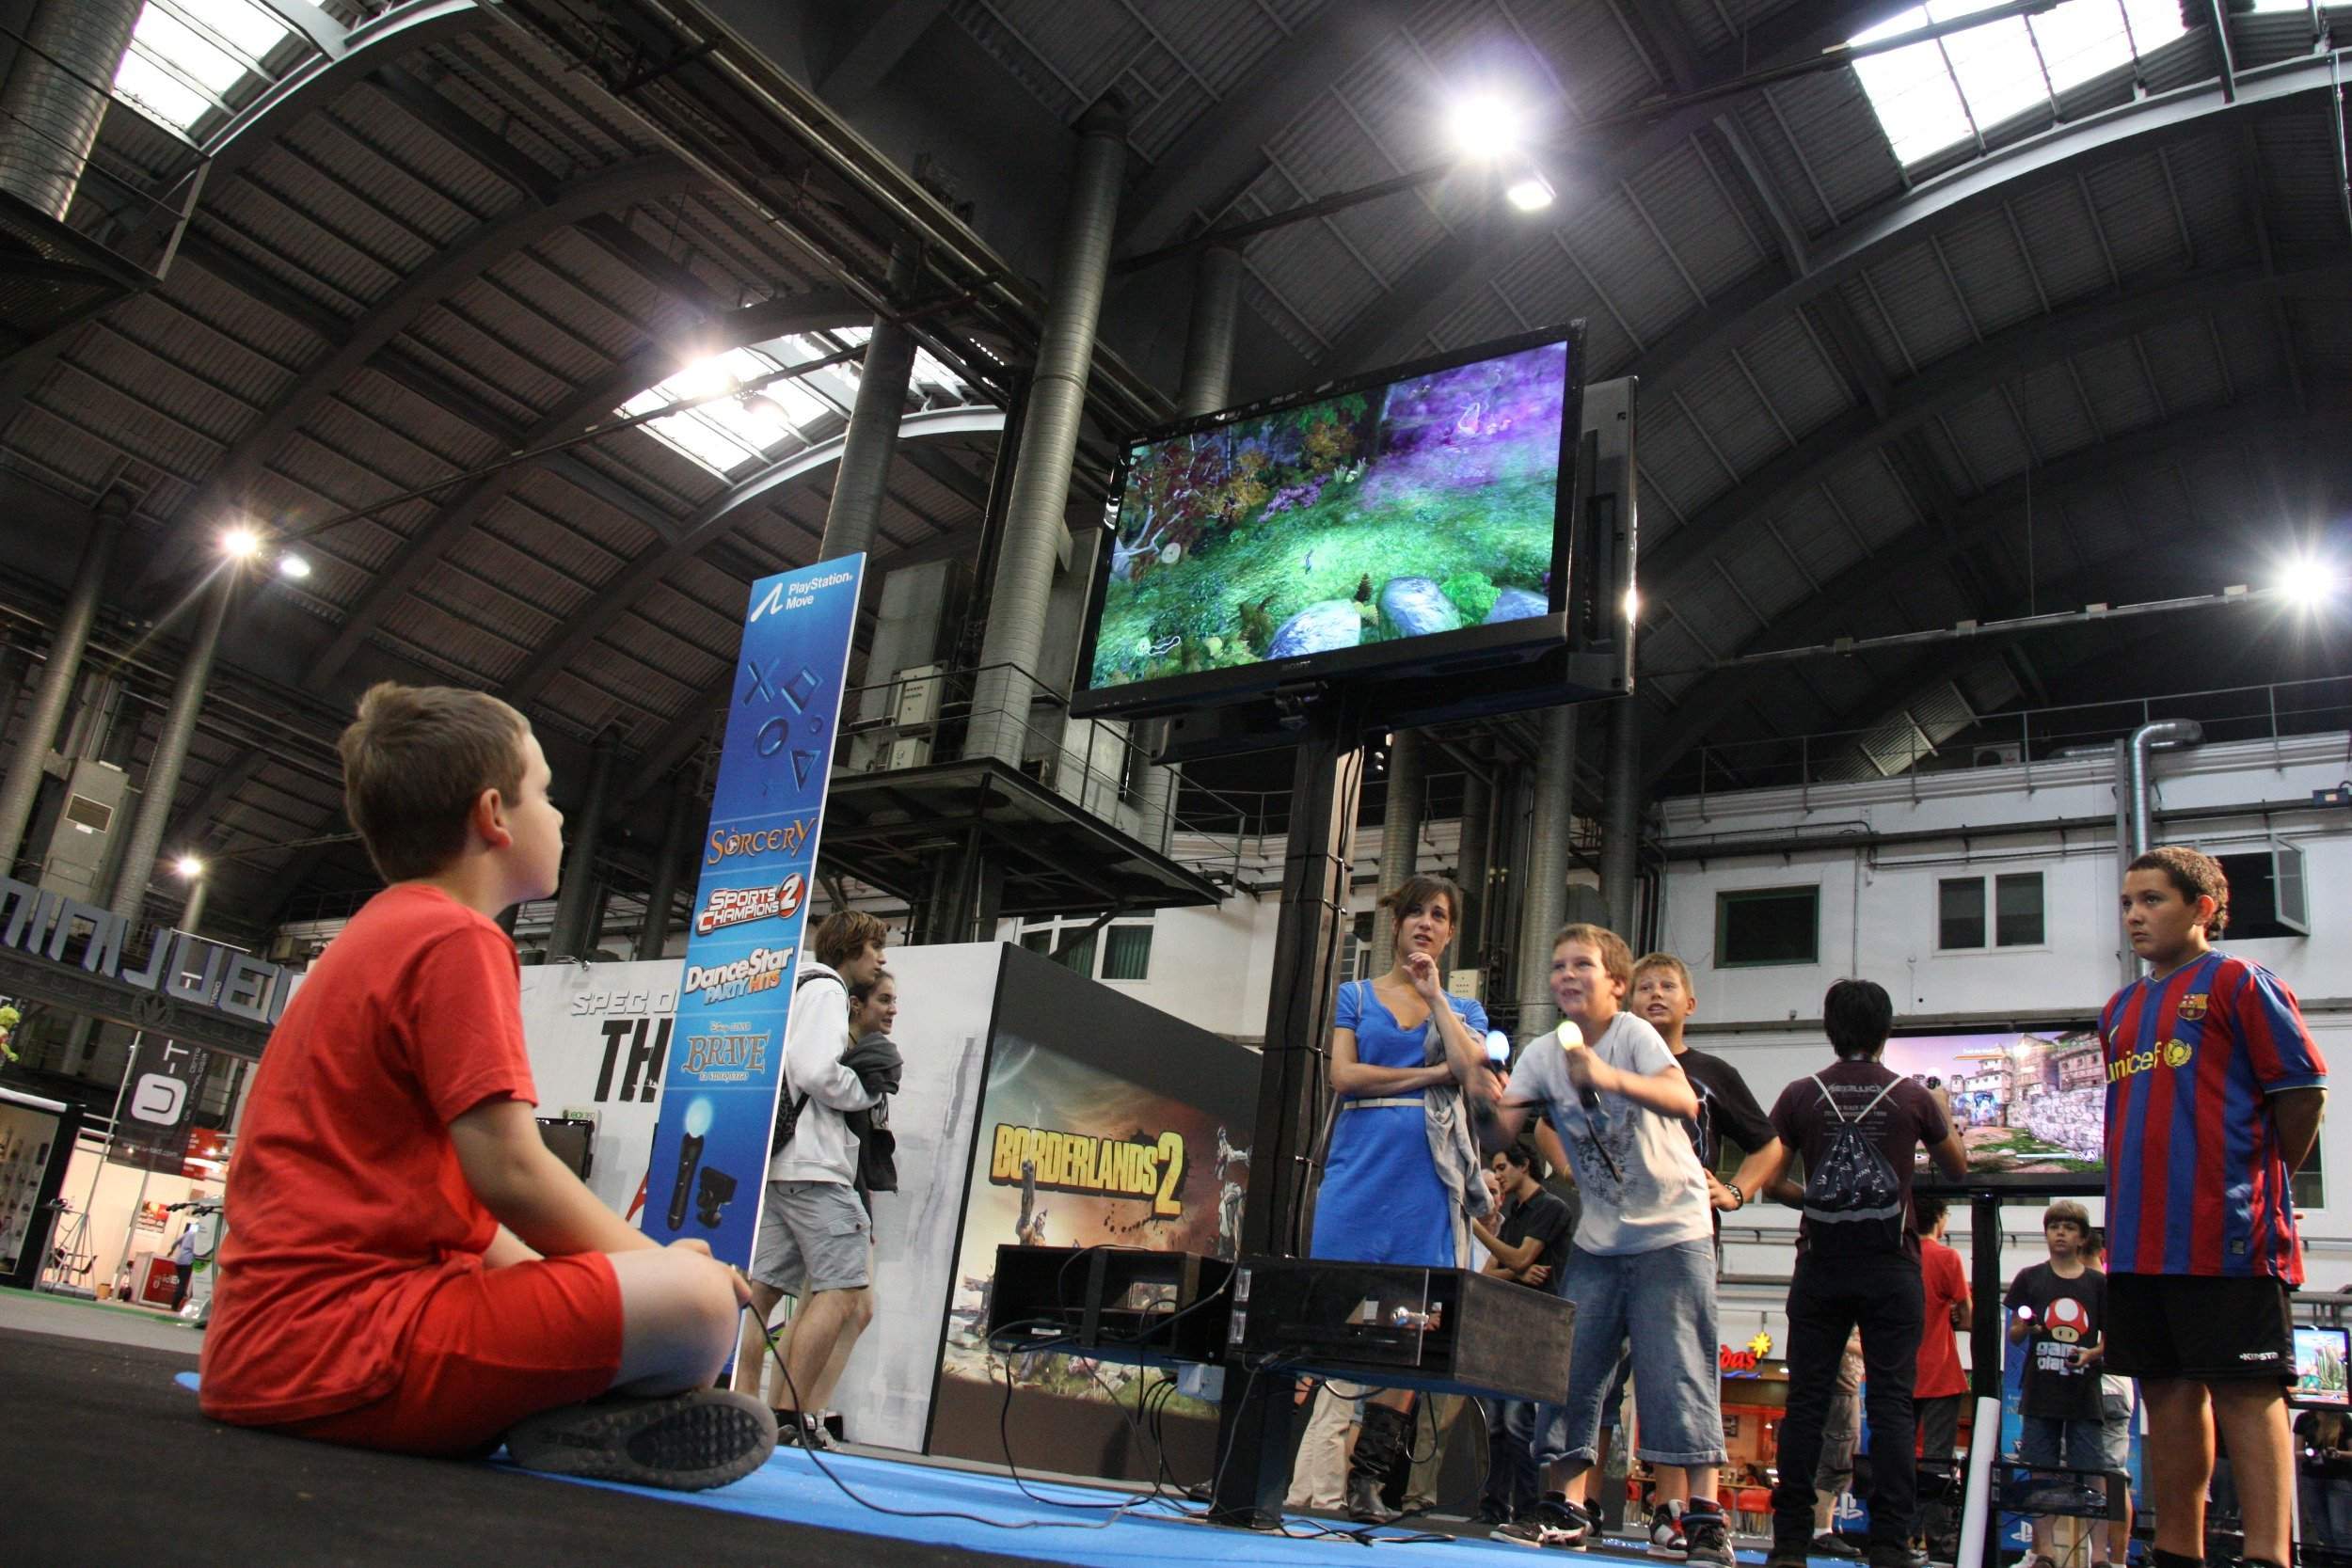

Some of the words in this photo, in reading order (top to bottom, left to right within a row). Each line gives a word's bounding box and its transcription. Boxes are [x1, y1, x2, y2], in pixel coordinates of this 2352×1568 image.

[786, 594, 814, 610] Move
[788, 572, 850, 595] PlayStation
[707, 817, 817, 865] SORCERY
[698, 900, 780, 932] CHAMPIONS
[779, 874, 802, 911] 2
[709, 886, 778, 911] SPORTS
[685, 947, 794, 994] DanceStar
[705, 978, 750, 1005] PARTY
[748, 970, 782, 993] HITS
[571, 990, 649, 1016] SPEC
[594, 1018, 674, 1103] TH
[682, 1032, 771, 1073] BRAVE
[2107, 1041, 2162, 1084] unicef
[991, 1124, 1159, 1196] BORDERLANDS
[1154, 1132, 1184, 1215] 2
[1719, 1343, 1756, 1370] das
